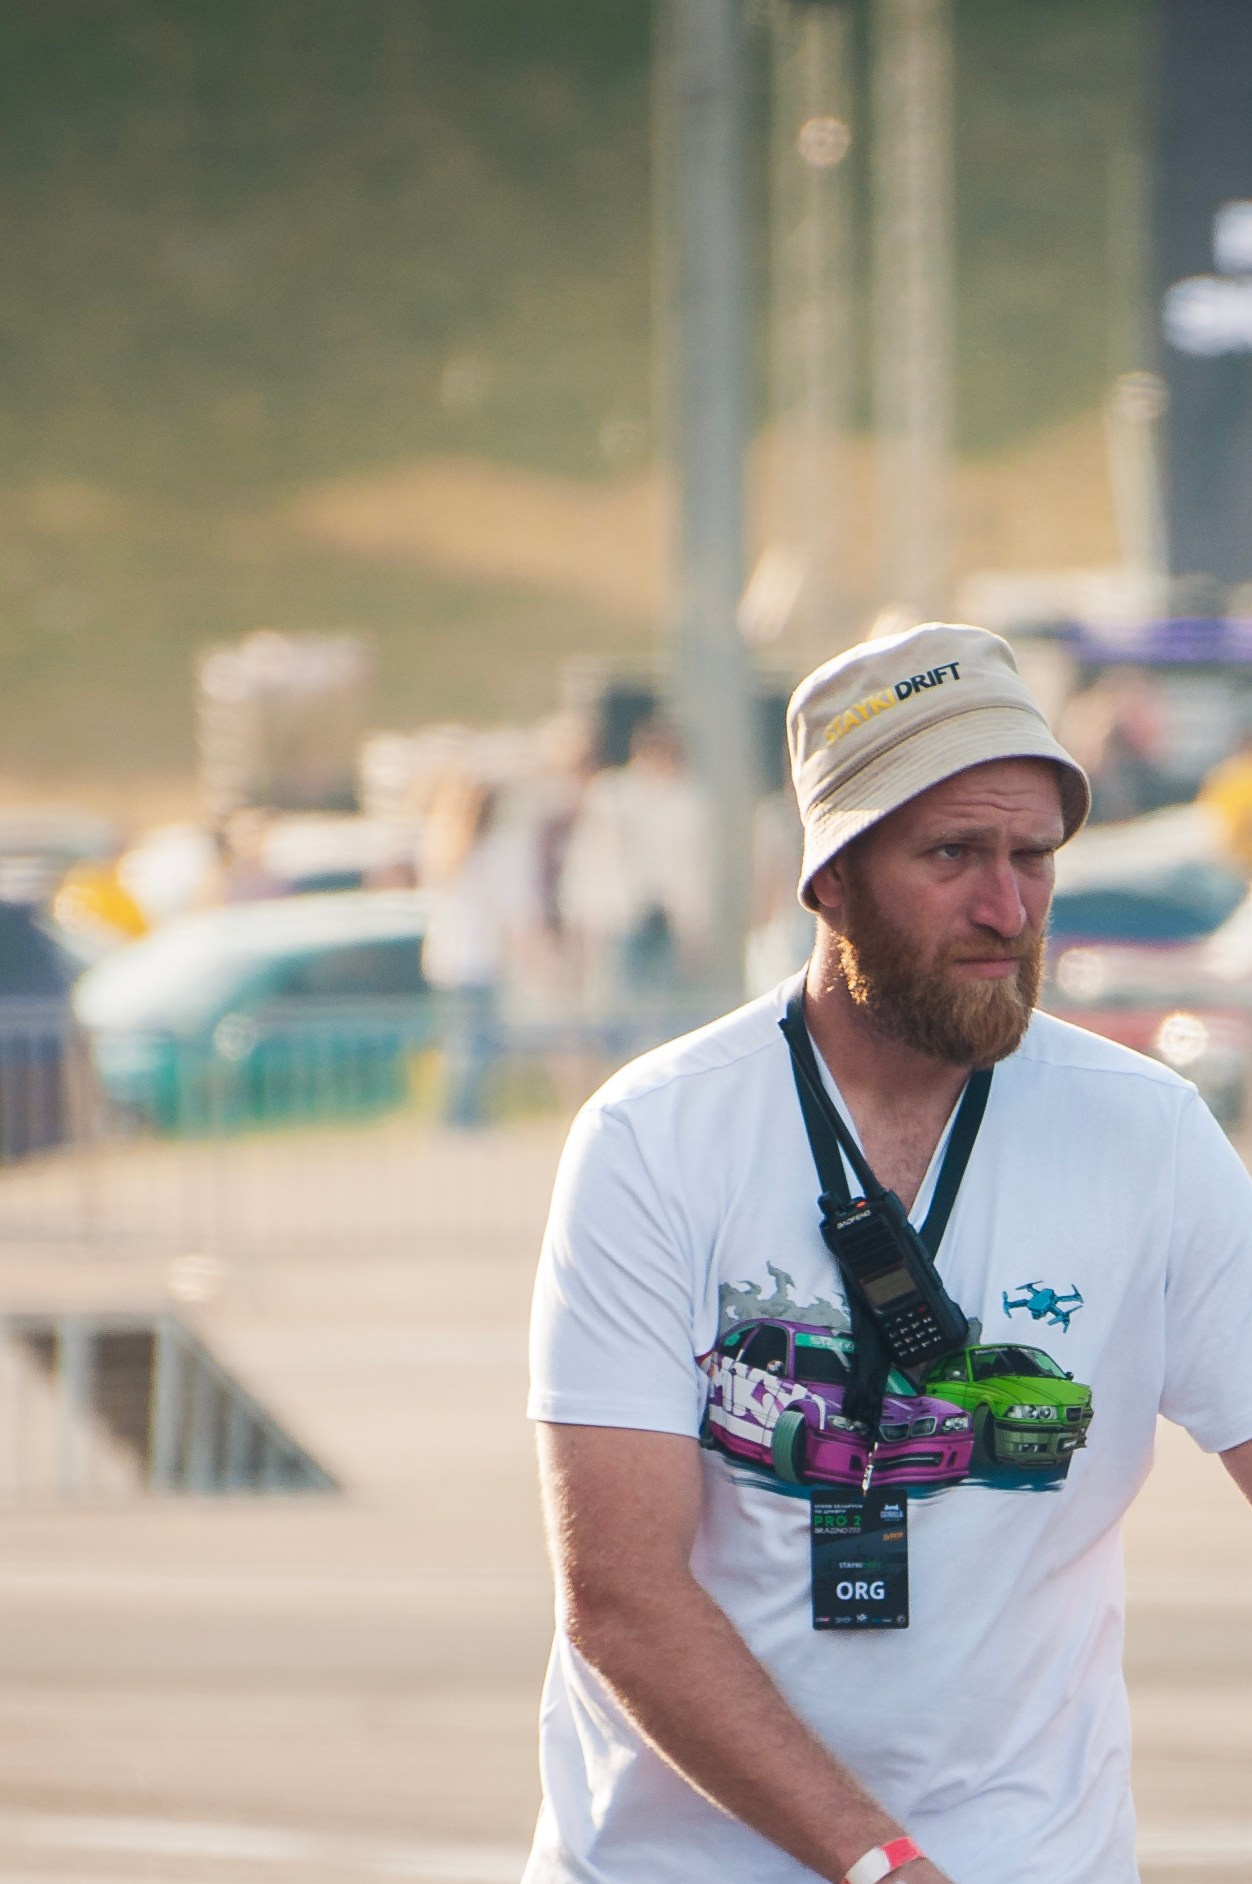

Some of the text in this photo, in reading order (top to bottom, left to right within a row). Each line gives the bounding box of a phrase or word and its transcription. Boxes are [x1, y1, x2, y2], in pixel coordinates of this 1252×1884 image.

[814, 1515, 862, 1527] PRO 2
[836, 1581, 885, 1600] ORG
